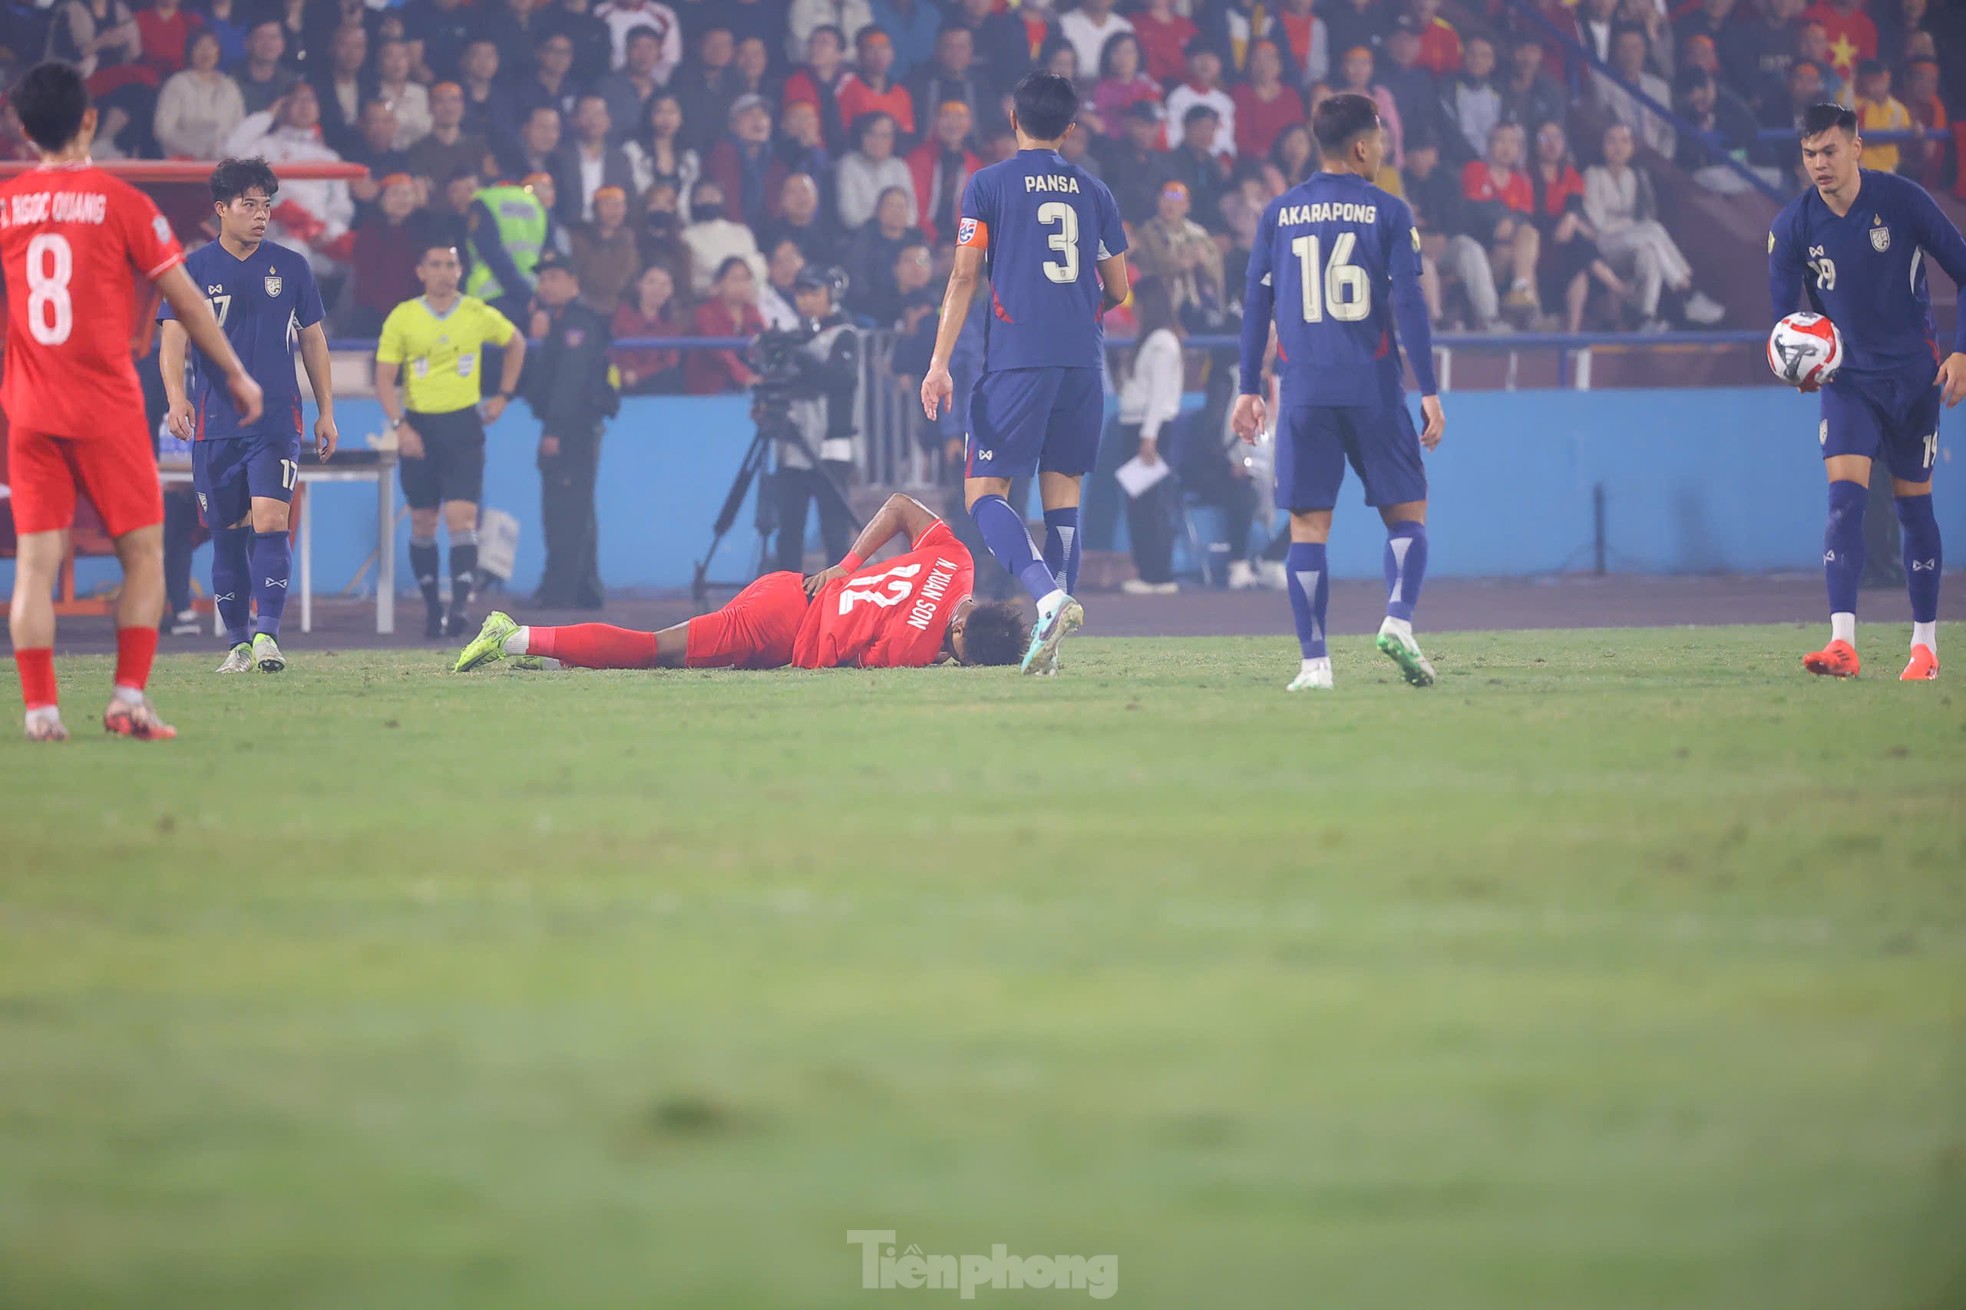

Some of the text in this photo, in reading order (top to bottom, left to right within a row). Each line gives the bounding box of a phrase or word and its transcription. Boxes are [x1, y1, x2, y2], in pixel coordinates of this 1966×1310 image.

[1024, 175, 1080, 194] PANSA
[1278, 202, 1377, 227] AKARAPONG
[1037, 201, 1079, 284] 3
[26, 233, 73, 345] 8
[1291, 231, 1371, 323] 16
[280, 458, 298, 491] 17
[920, 567, 954, 601] XUAN
[906, 599, 937, 631] SON
